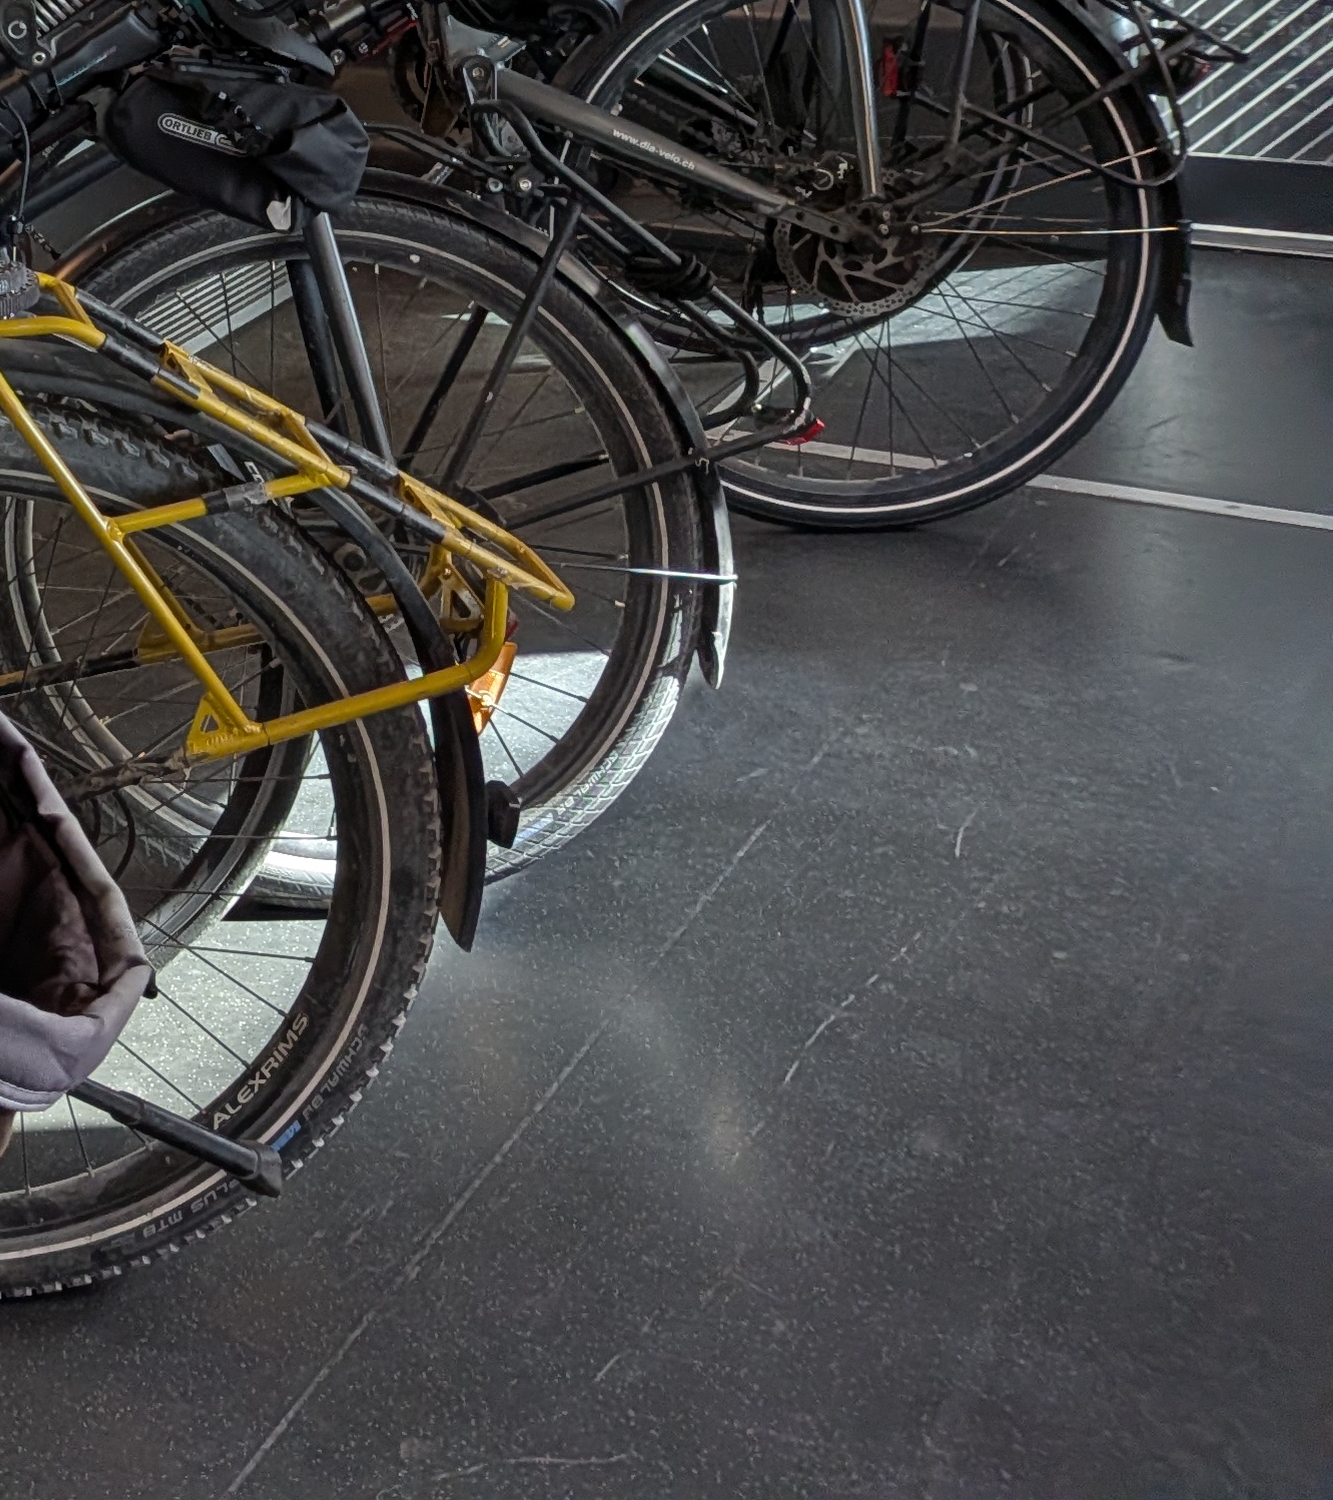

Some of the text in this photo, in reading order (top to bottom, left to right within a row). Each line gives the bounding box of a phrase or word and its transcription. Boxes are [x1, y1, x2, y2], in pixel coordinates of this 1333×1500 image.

[164, 117, 213, 141] ORTLIEB
[613, 129, 695, 170] www.dia-velo.ch
[212, 1012, 309, 1130] ALEXRIMS
[143, 1213, 183, 1238] MTB
